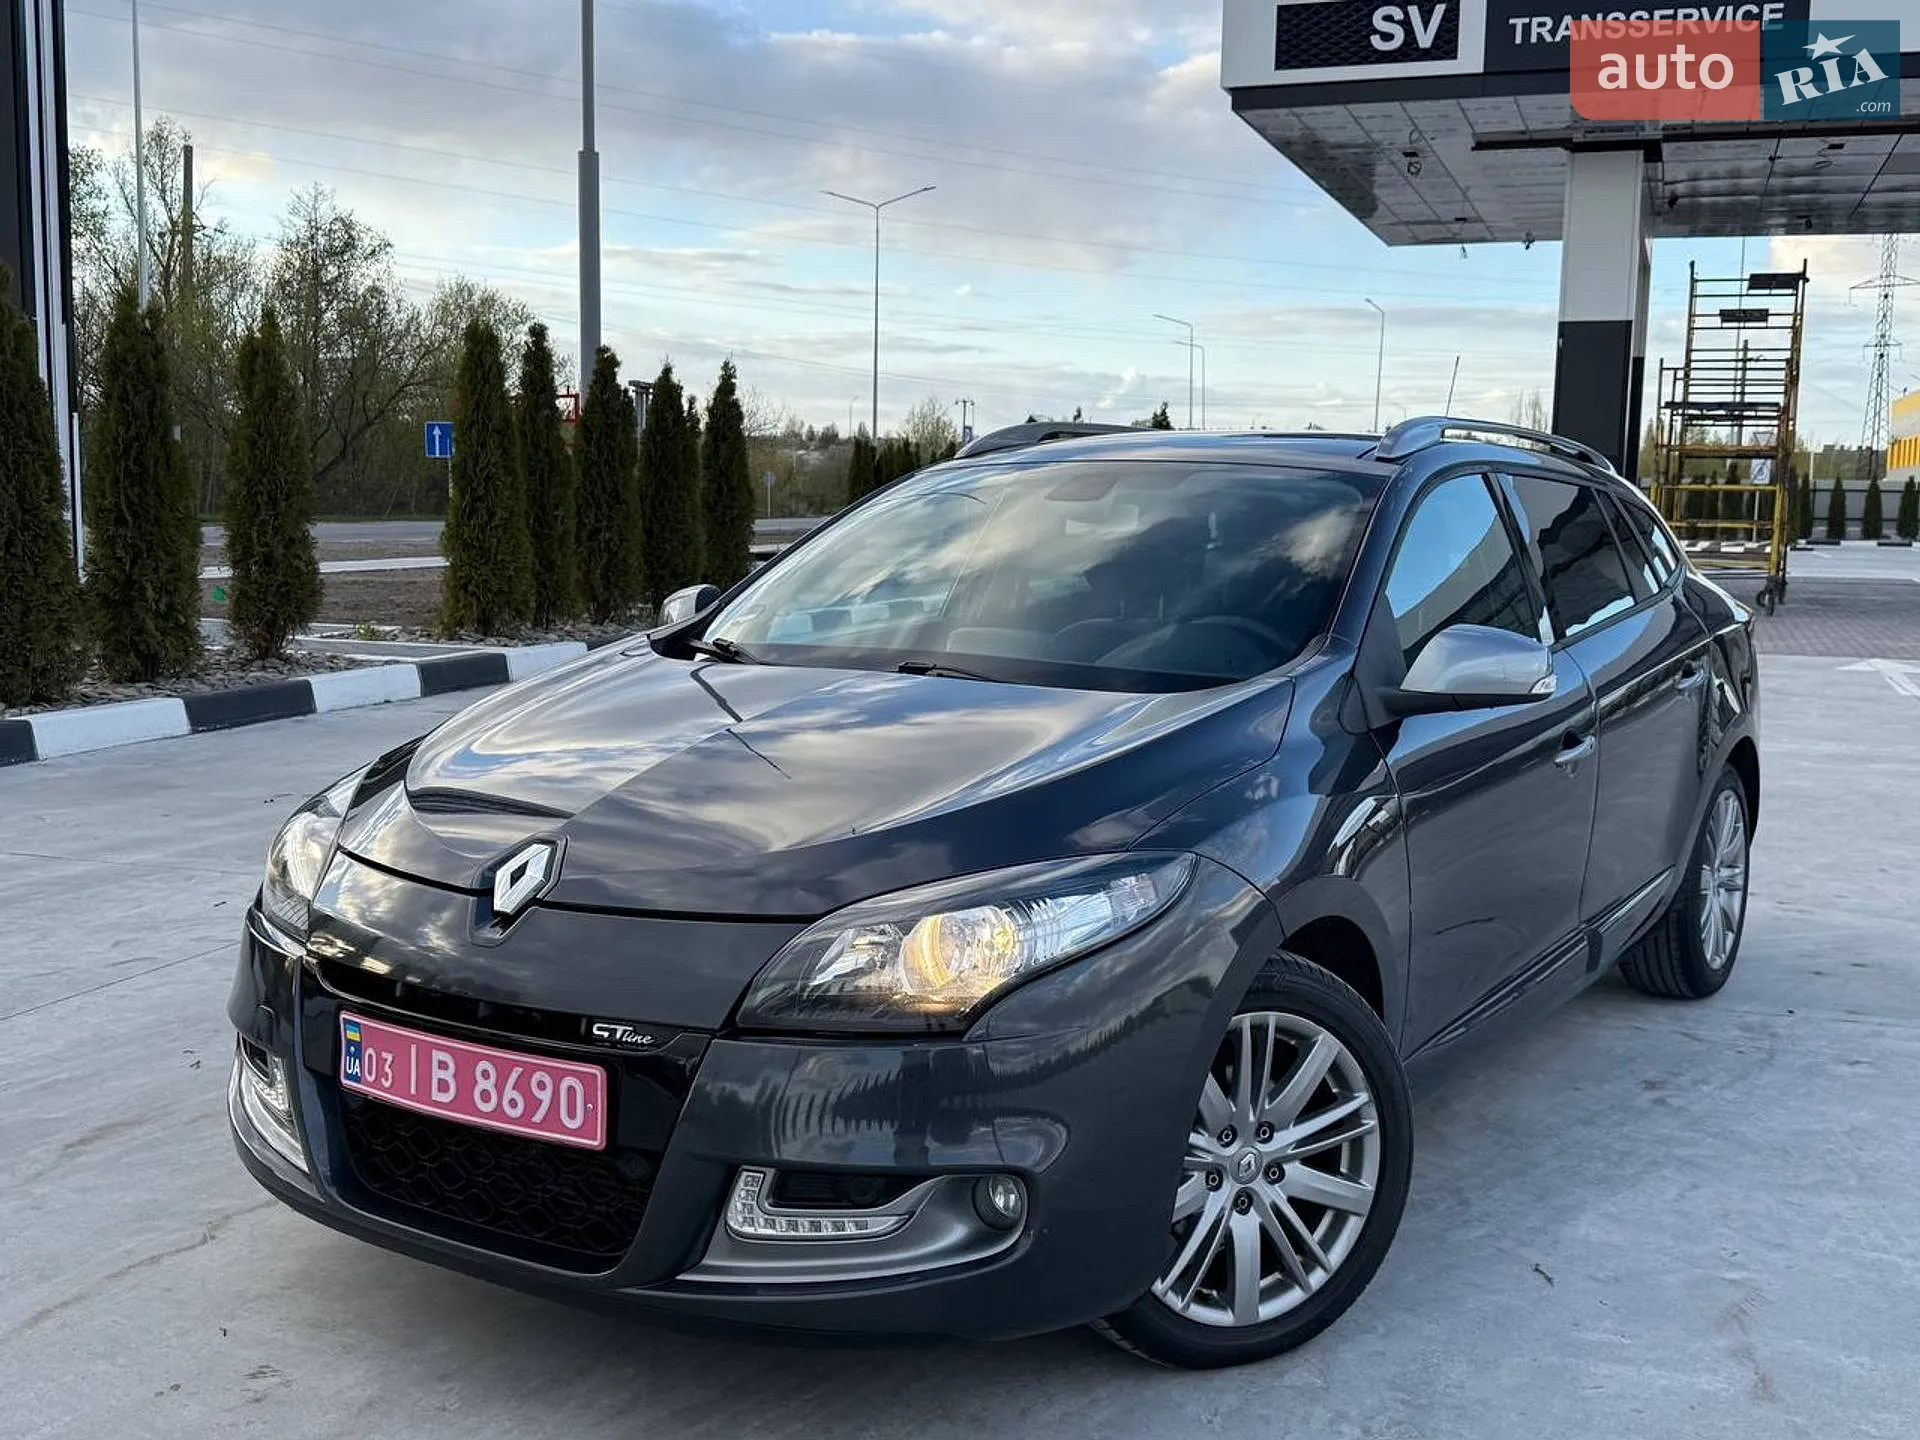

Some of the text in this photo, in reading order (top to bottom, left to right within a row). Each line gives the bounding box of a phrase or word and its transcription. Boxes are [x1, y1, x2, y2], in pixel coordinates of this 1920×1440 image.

[1370, 2, 1784, 50] SV TRANSSERVICE
[346, 1058, 361, 1077] UA
[365, 1047, 393, 1089] 03
[473, 1060, 585, 1130] 8690
